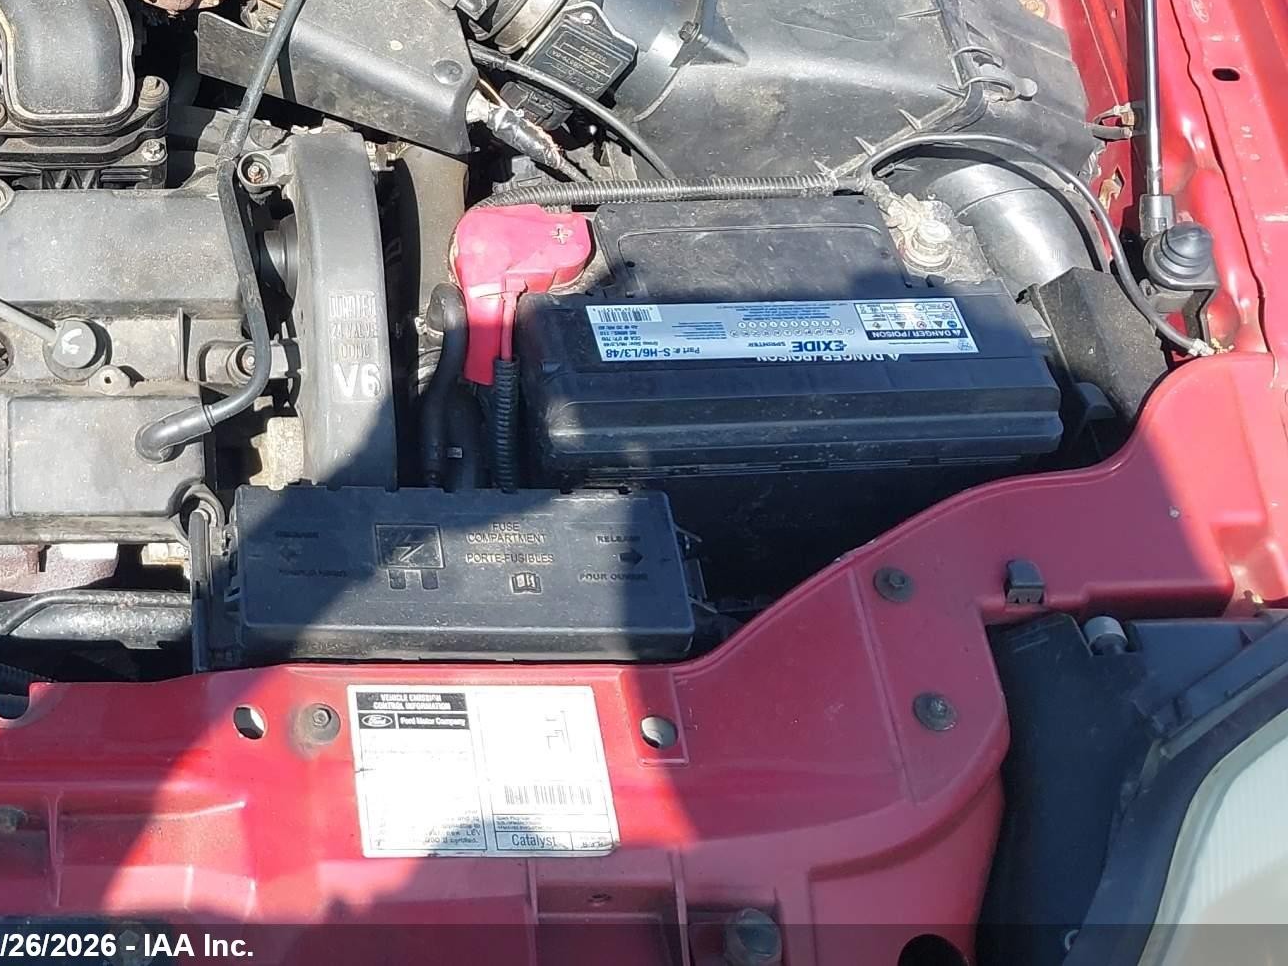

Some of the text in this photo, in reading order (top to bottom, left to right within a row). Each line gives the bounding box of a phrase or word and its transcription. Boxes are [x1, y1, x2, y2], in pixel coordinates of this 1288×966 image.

[345, 321, 379, 339] VALVE
[872, 330, 907, 338] POISON
[791, 340, 846, 353] EXIDE
[605, 347, 671, 358] S-H6/L3/48
[332, 363, 381, 398] V6
[492, 521, 520, 532] FUSE
[466, 532, 547, 545] COMPARTMENT
[465, 552, 554, 564] PORTE-FUSIBLES
[578, 572, 609, 582] POUR
[380, 693, 408, 702] VEHICLE
[373, 701, 452, 710] CONTROL INFORMATION
[399, 717, 466, 727] Ford Motor Company
[511, 833, 558, 847] Catalyst
